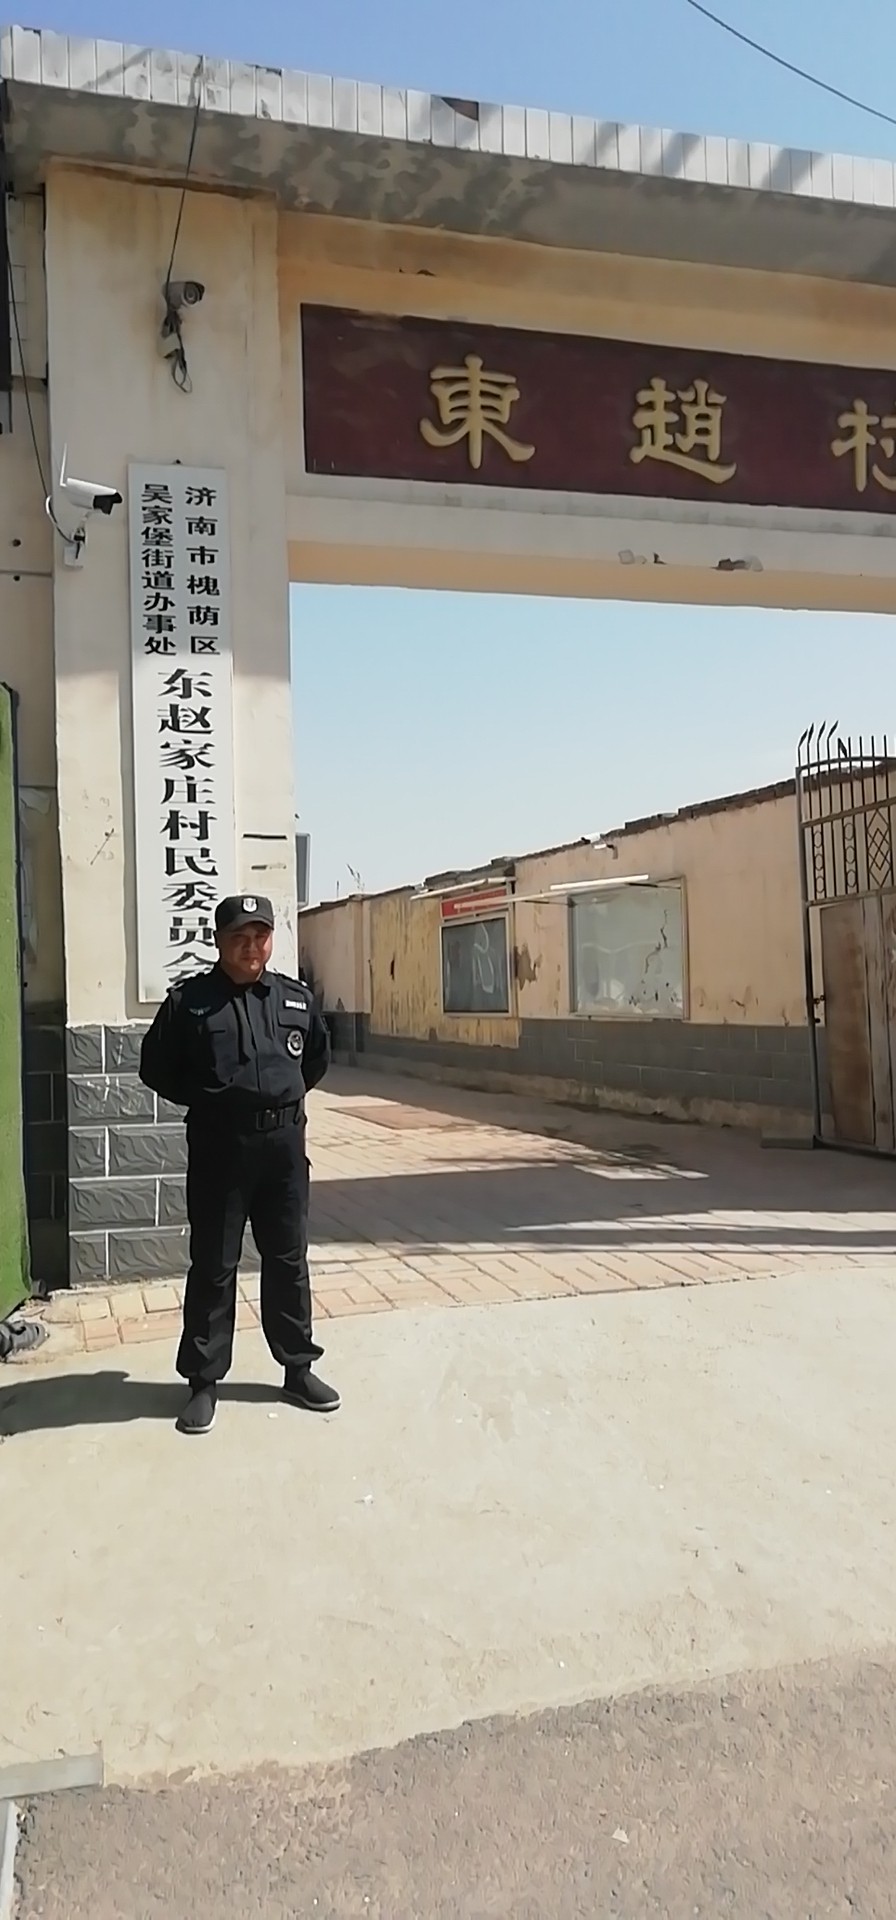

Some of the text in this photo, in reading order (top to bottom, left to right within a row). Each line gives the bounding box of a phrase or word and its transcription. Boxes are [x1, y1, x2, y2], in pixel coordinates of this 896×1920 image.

[141, 484, 177, 656] 吴家堡街道办事处
[185, 486, 220, 655] 济南市槐荫区
